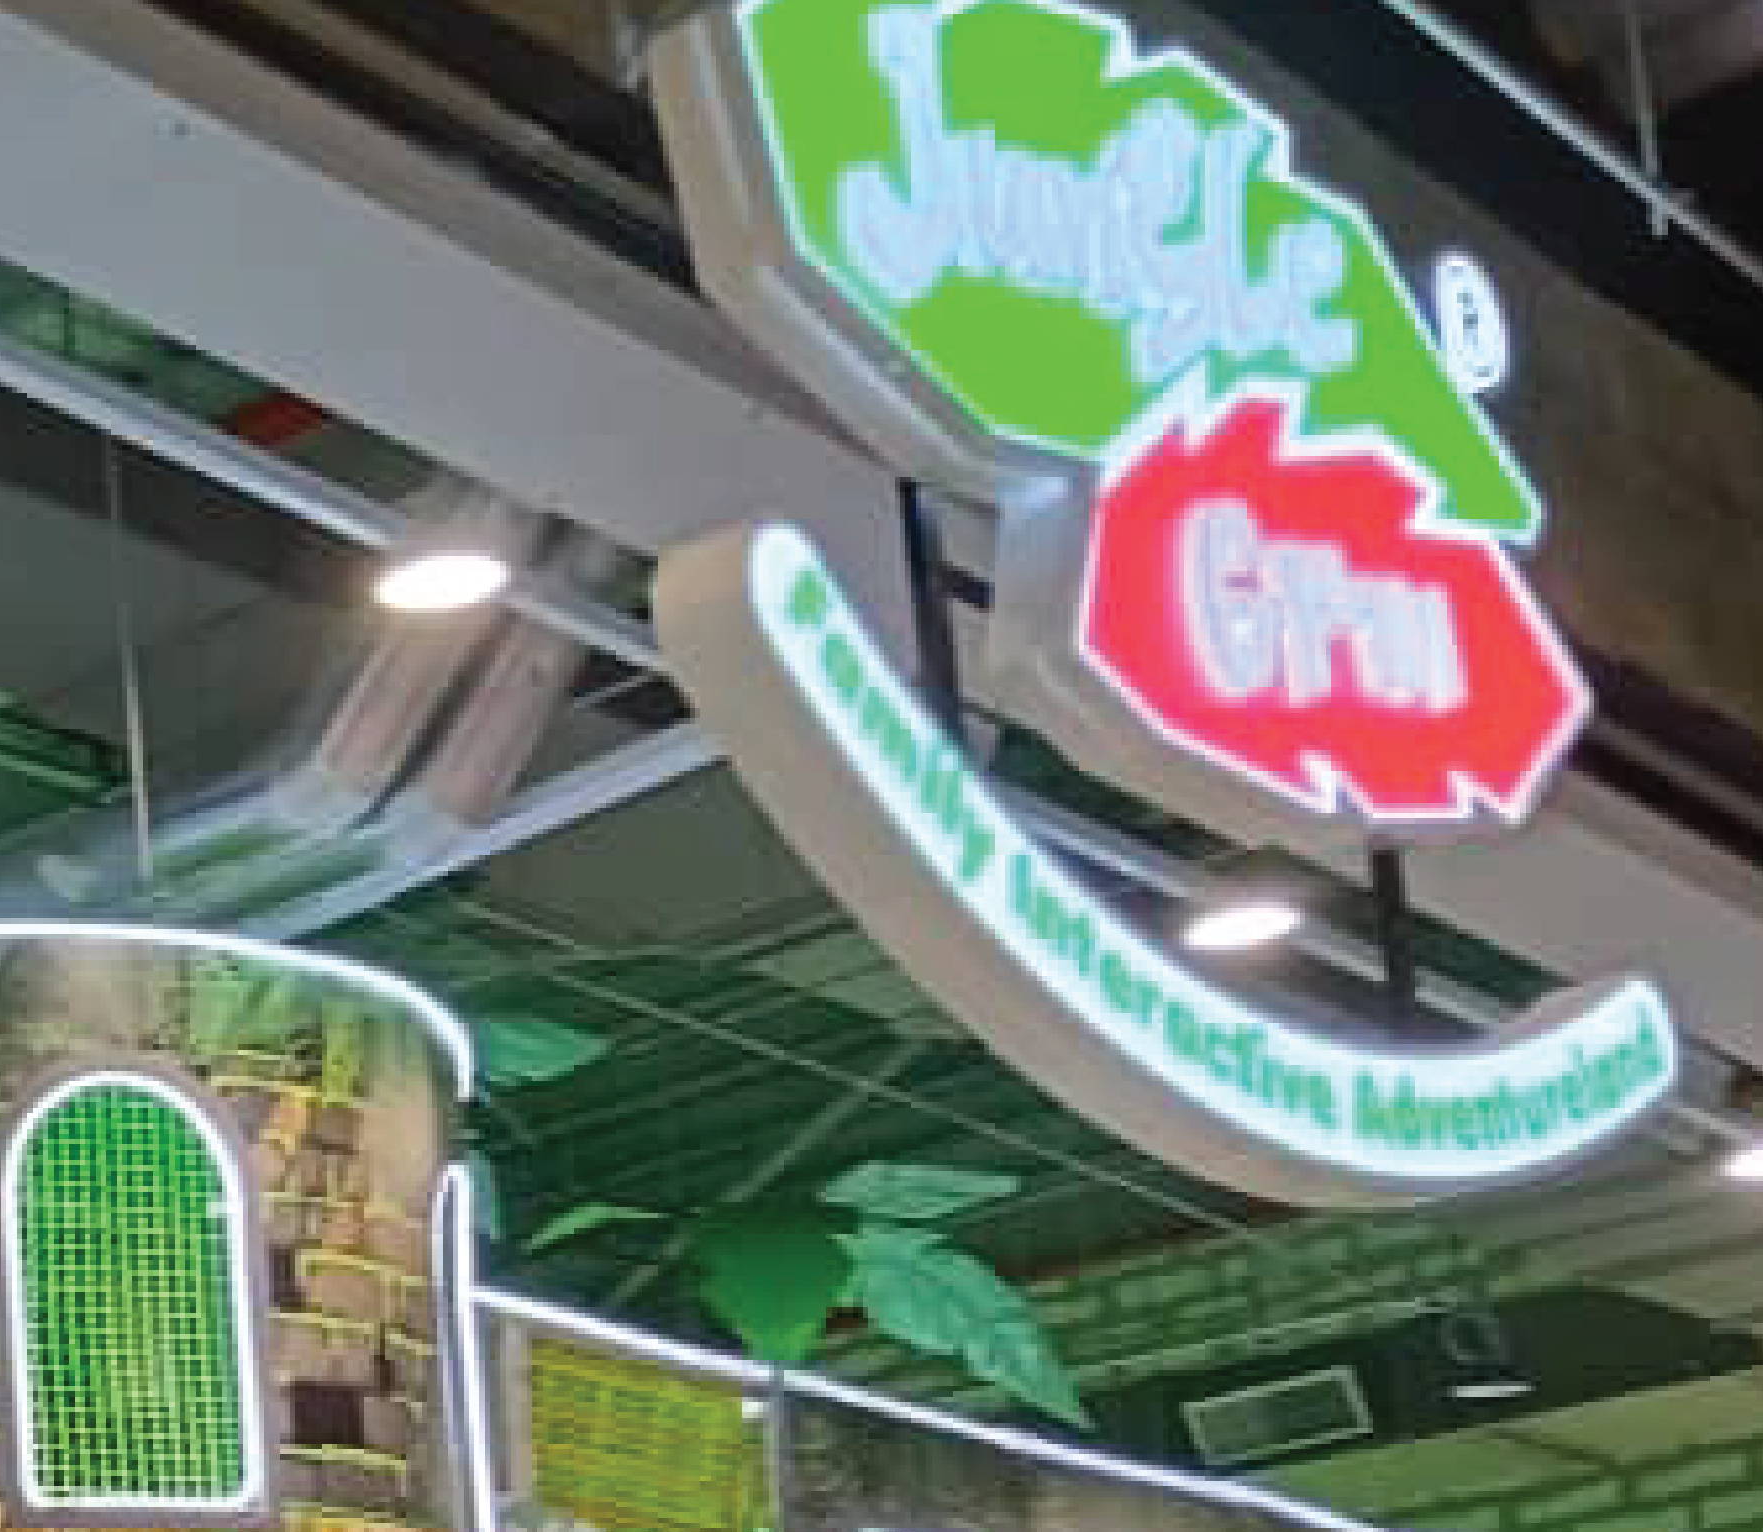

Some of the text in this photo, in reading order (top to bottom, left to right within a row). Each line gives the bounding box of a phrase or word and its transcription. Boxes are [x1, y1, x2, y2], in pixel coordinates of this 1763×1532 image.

[783, 562, 1665, 1150] Family Interactive Adventureland
